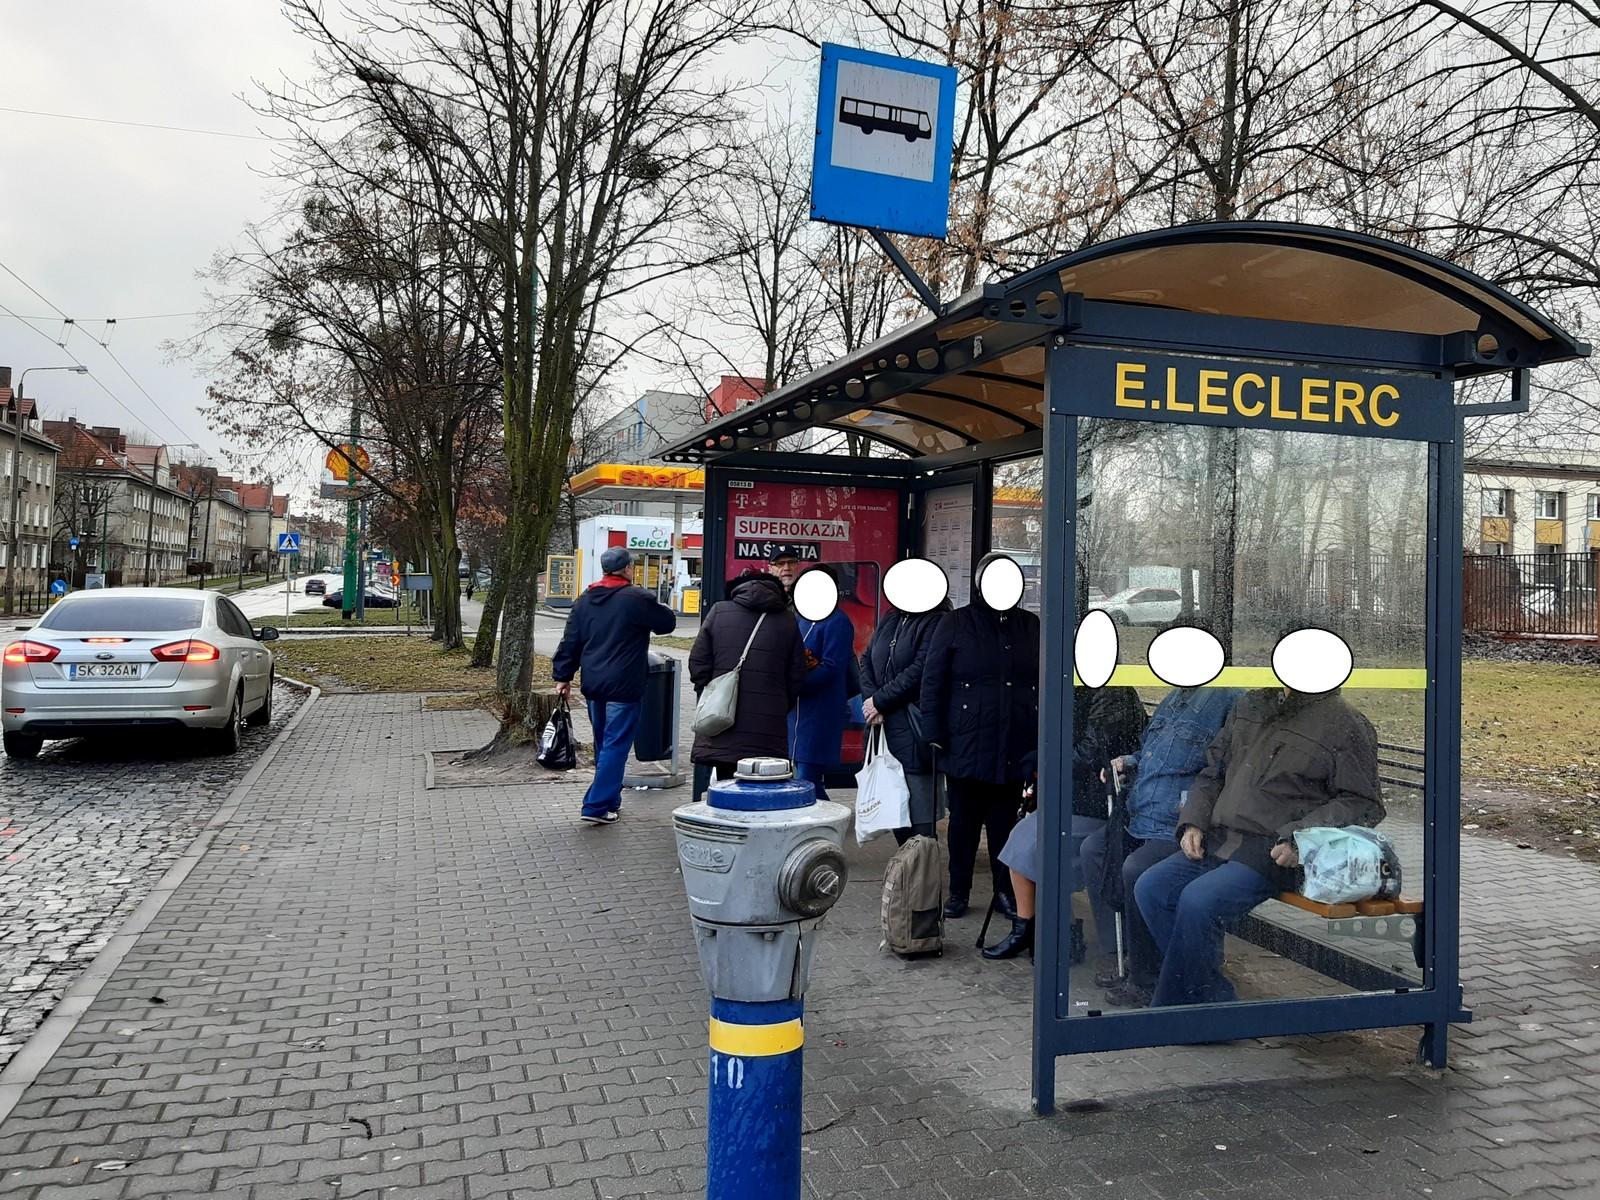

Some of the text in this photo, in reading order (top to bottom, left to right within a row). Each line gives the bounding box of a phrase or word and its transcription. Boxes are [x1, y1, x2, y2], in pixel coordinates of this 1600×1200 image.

[1115, 362, 1400, 427] E.LECLERC
[620, 469, 686, 488] Shell
[739, 520, 846, 538] SUPEROKAZJA
[630, 536, 668, 548] Select
[738, 541, 818, 559] NA ŚTA
[78, 665, 138, 677] SK 326AW
[712, 1054, 743, 1090] 10
